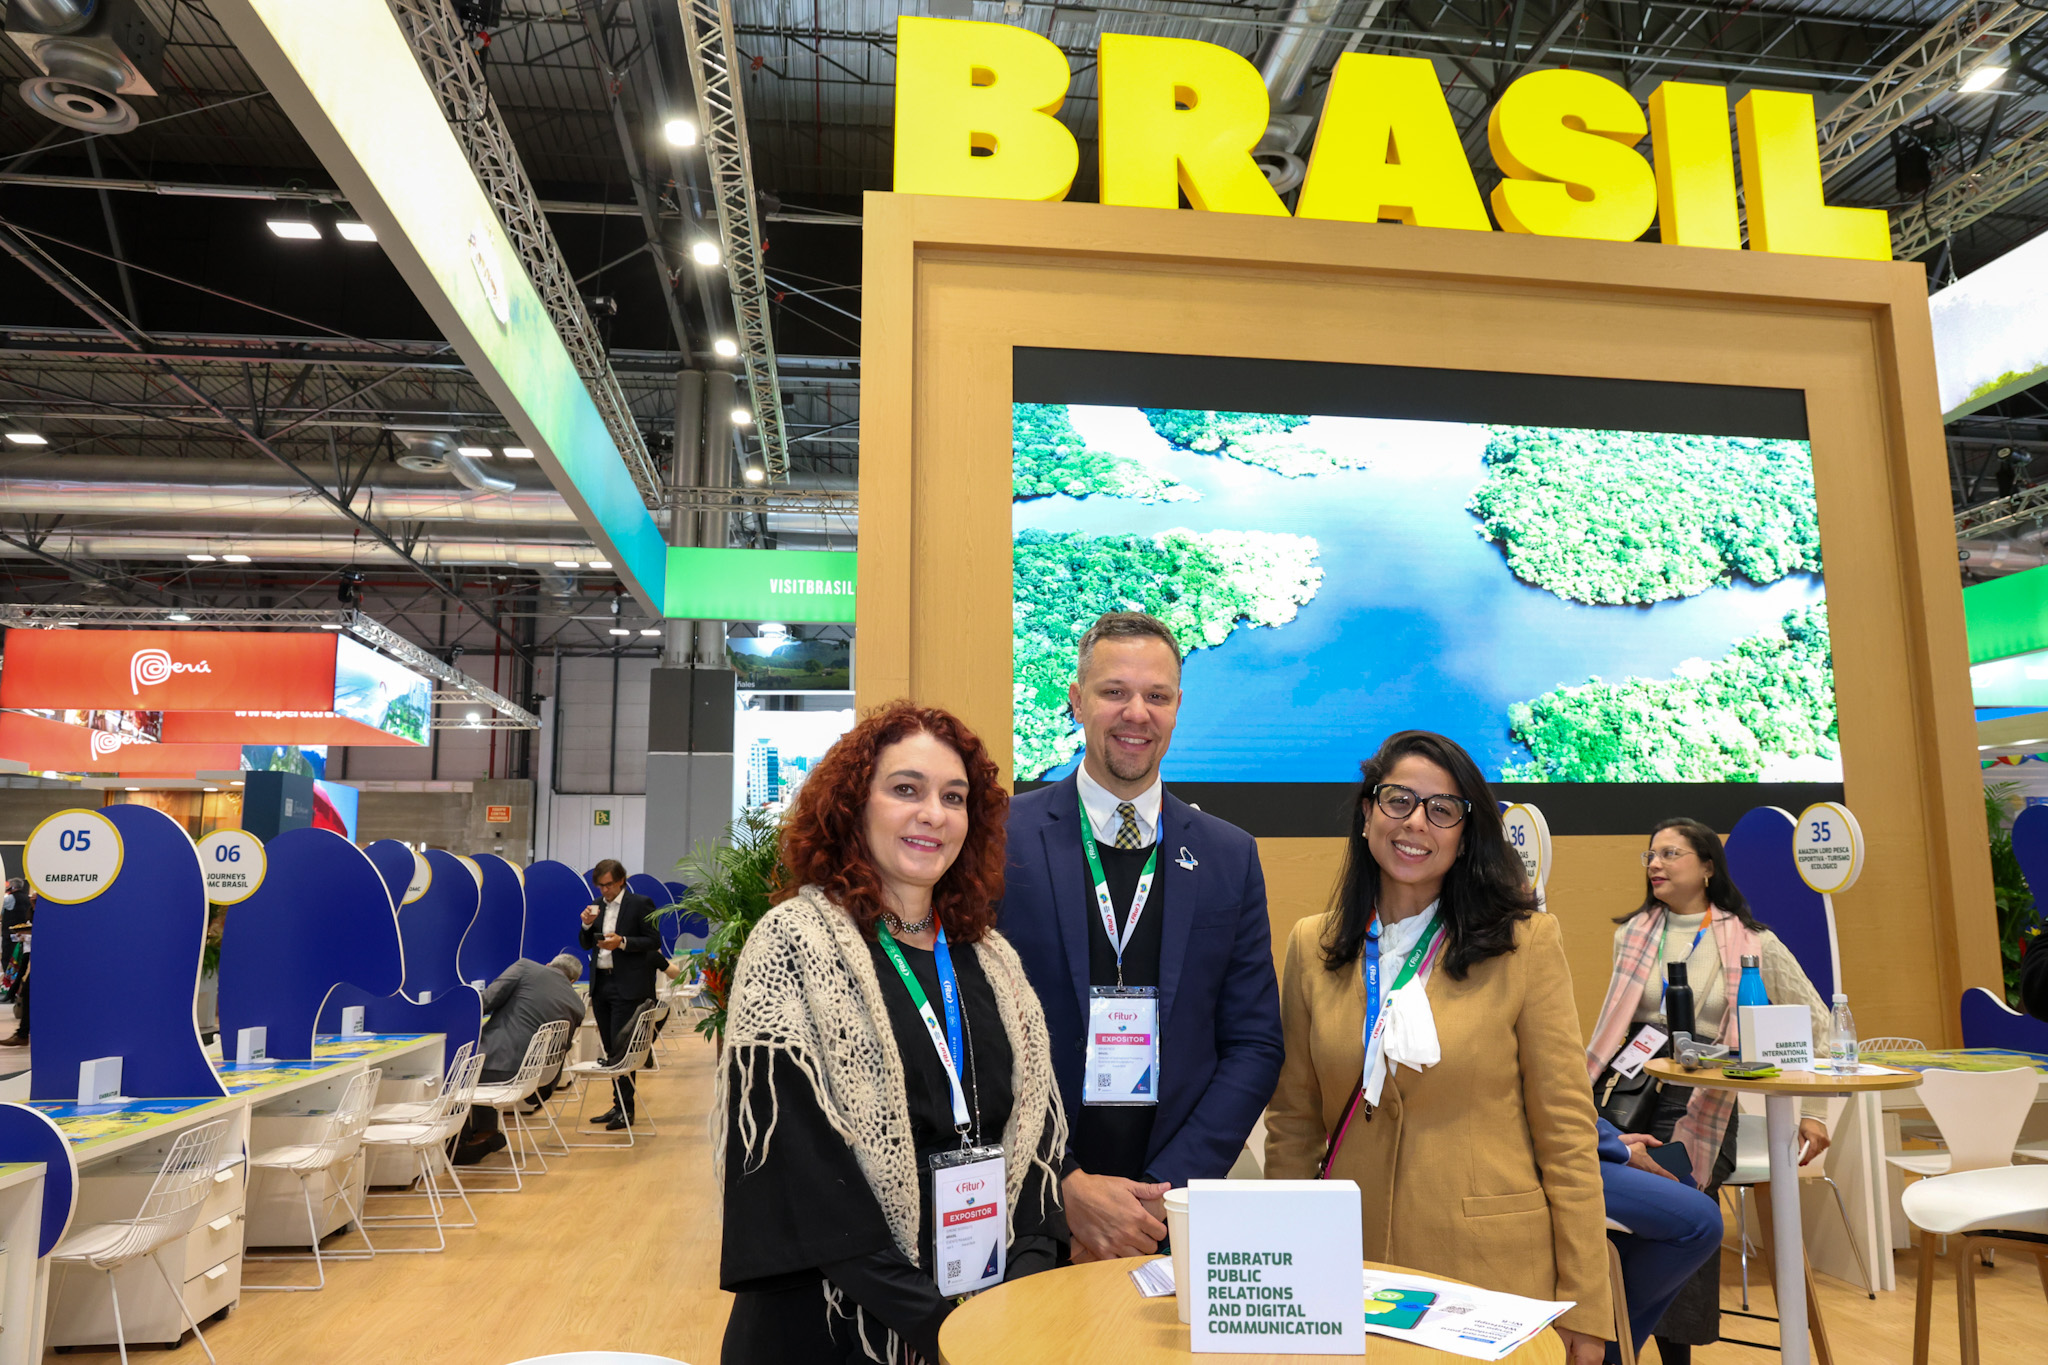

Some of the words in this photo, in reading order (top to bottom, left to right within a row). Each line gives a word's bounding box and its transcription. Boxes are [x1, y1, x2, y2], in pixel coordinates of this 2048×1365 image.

[893, 15, 1893, 261] BRASIL
[769, 578, 855, 595] VISITBRASIL
[130, 648, 212, 695] Perú
[1510, 825, 1525, 846] 36
[1811, 821, 1831, 842] 35
[59, 829, 91, 852] 05
[215, 845, 241, 863] 06
[45, 874, 99, 883] EMBRATUR
[1762, 1049, 1807, 1057] INTERNATIONAL
[950, 1206, 992, 1222] EXPOSITOR
[1207, 1252, 1293, 1265] EMBRATUR
[1207, 1269, 1262, 1282] PUBLIC
[1208, 1286, 1293, 1300] RELATIONS
[1208, 1303, 1241, 1317] AND
[1246, 1304, 1306, 1317] DIGITAL
[1208, 1321, 1342, 1335] COMMUNICATION
